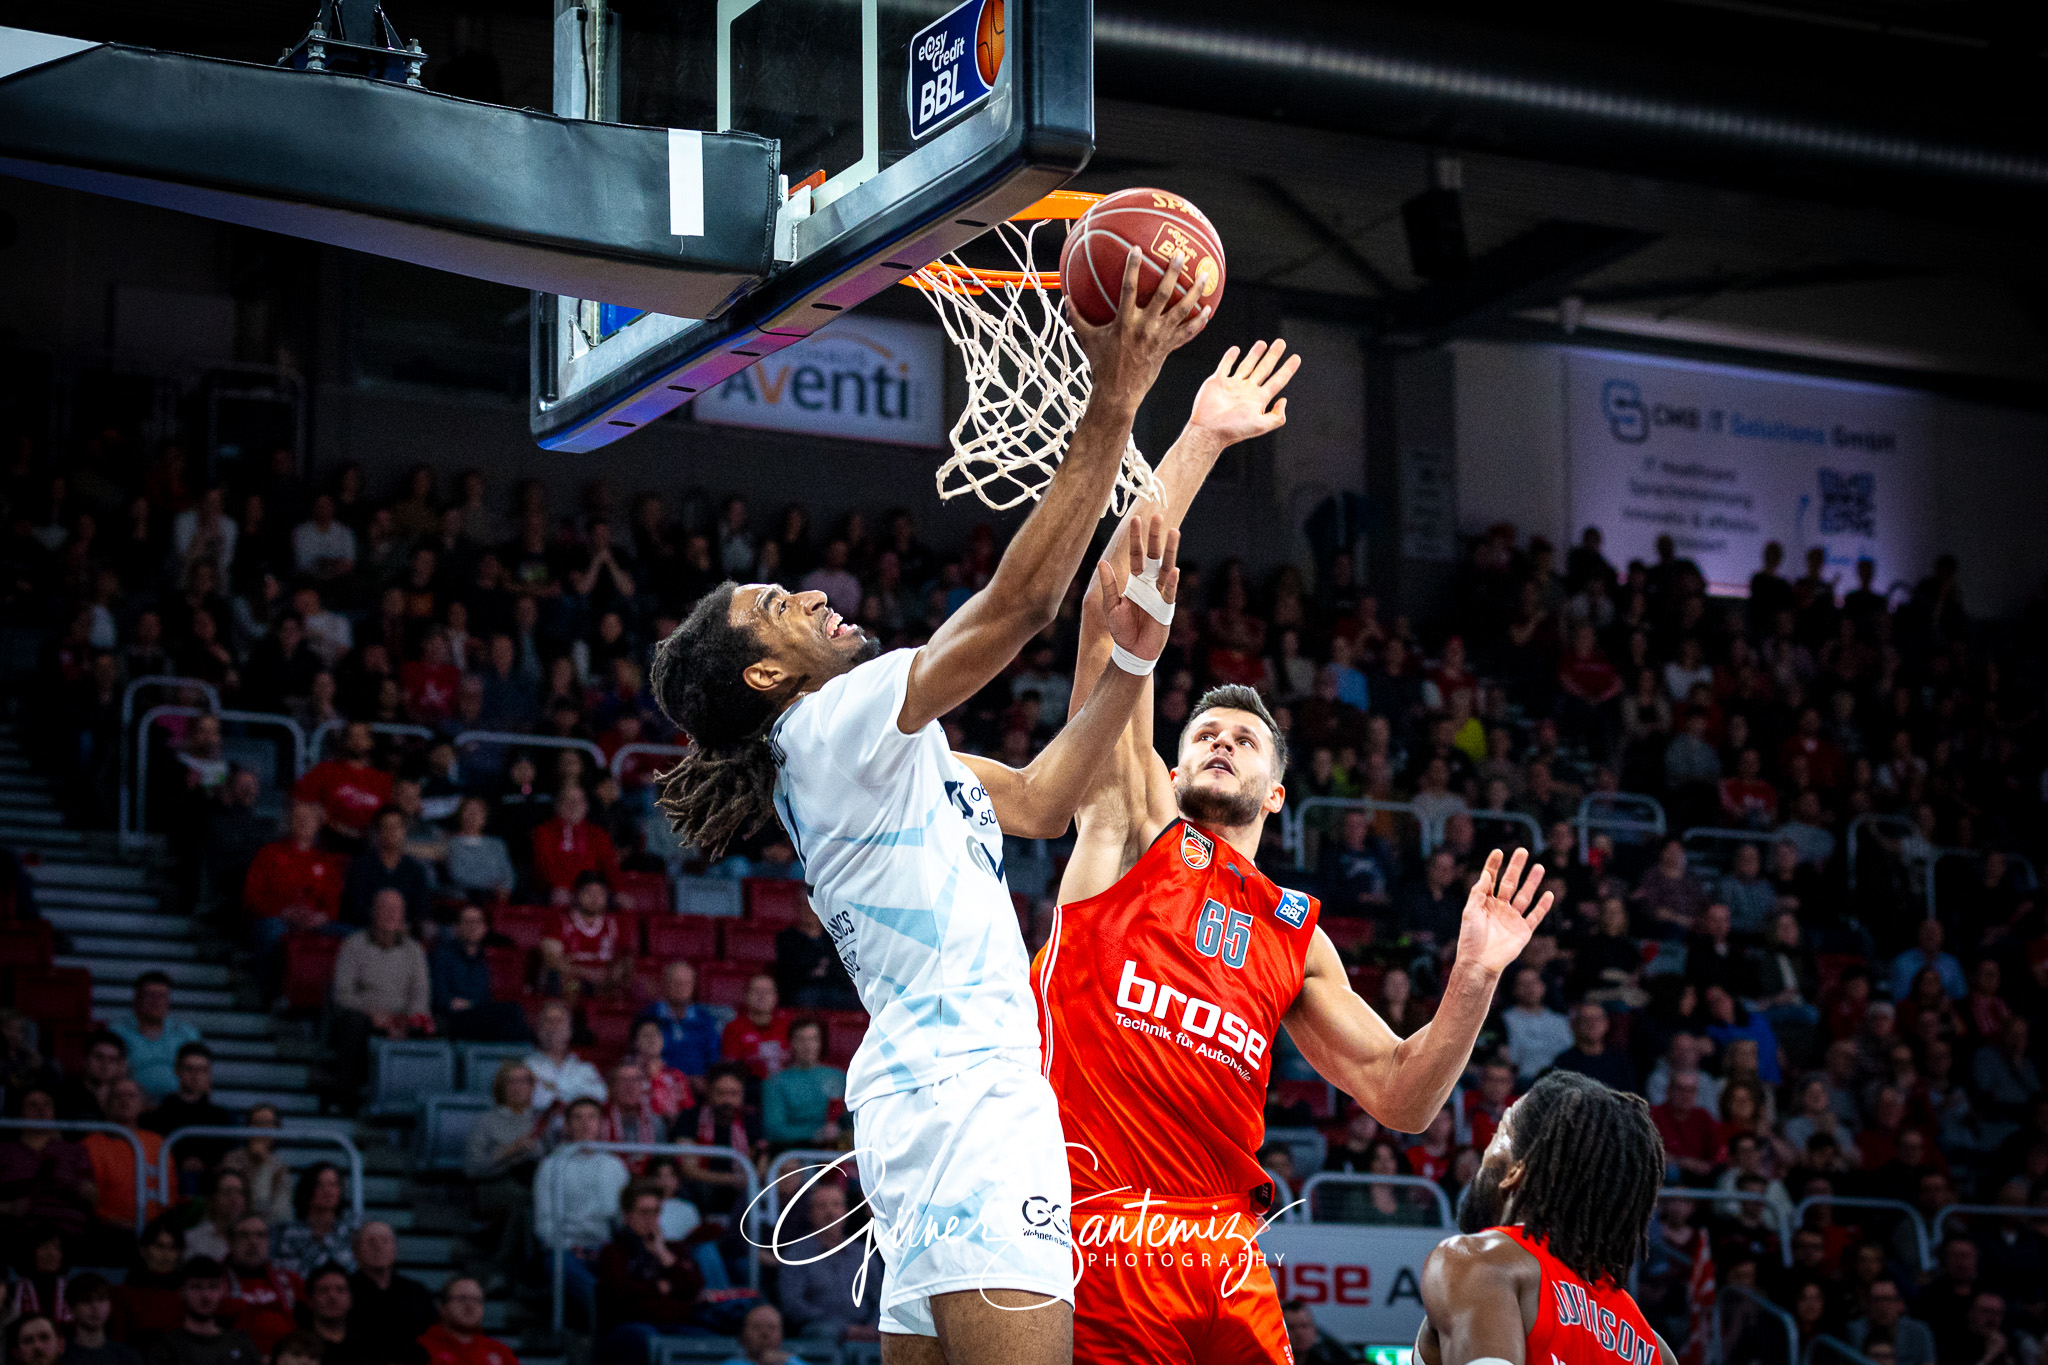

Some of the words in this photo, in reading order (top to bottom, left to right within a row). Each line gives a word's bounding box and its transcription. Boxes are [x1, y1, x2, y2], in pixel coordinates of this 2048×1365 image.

[932, 36, 965, 72] Credit
[918, 63, 965, 126] BBL
[721, 360, 909, 419] Aventi
[1195, 897, 1254, 969] 65
[1279, 902, 1302, 924] BBL
[1116, 959, 1268, 1070] brose
[1114, 1012, 1172, 1041] Technik
[1175, 1032, 1194, 1049] für
[1195, 1042, 1251, 1082] Autobile
